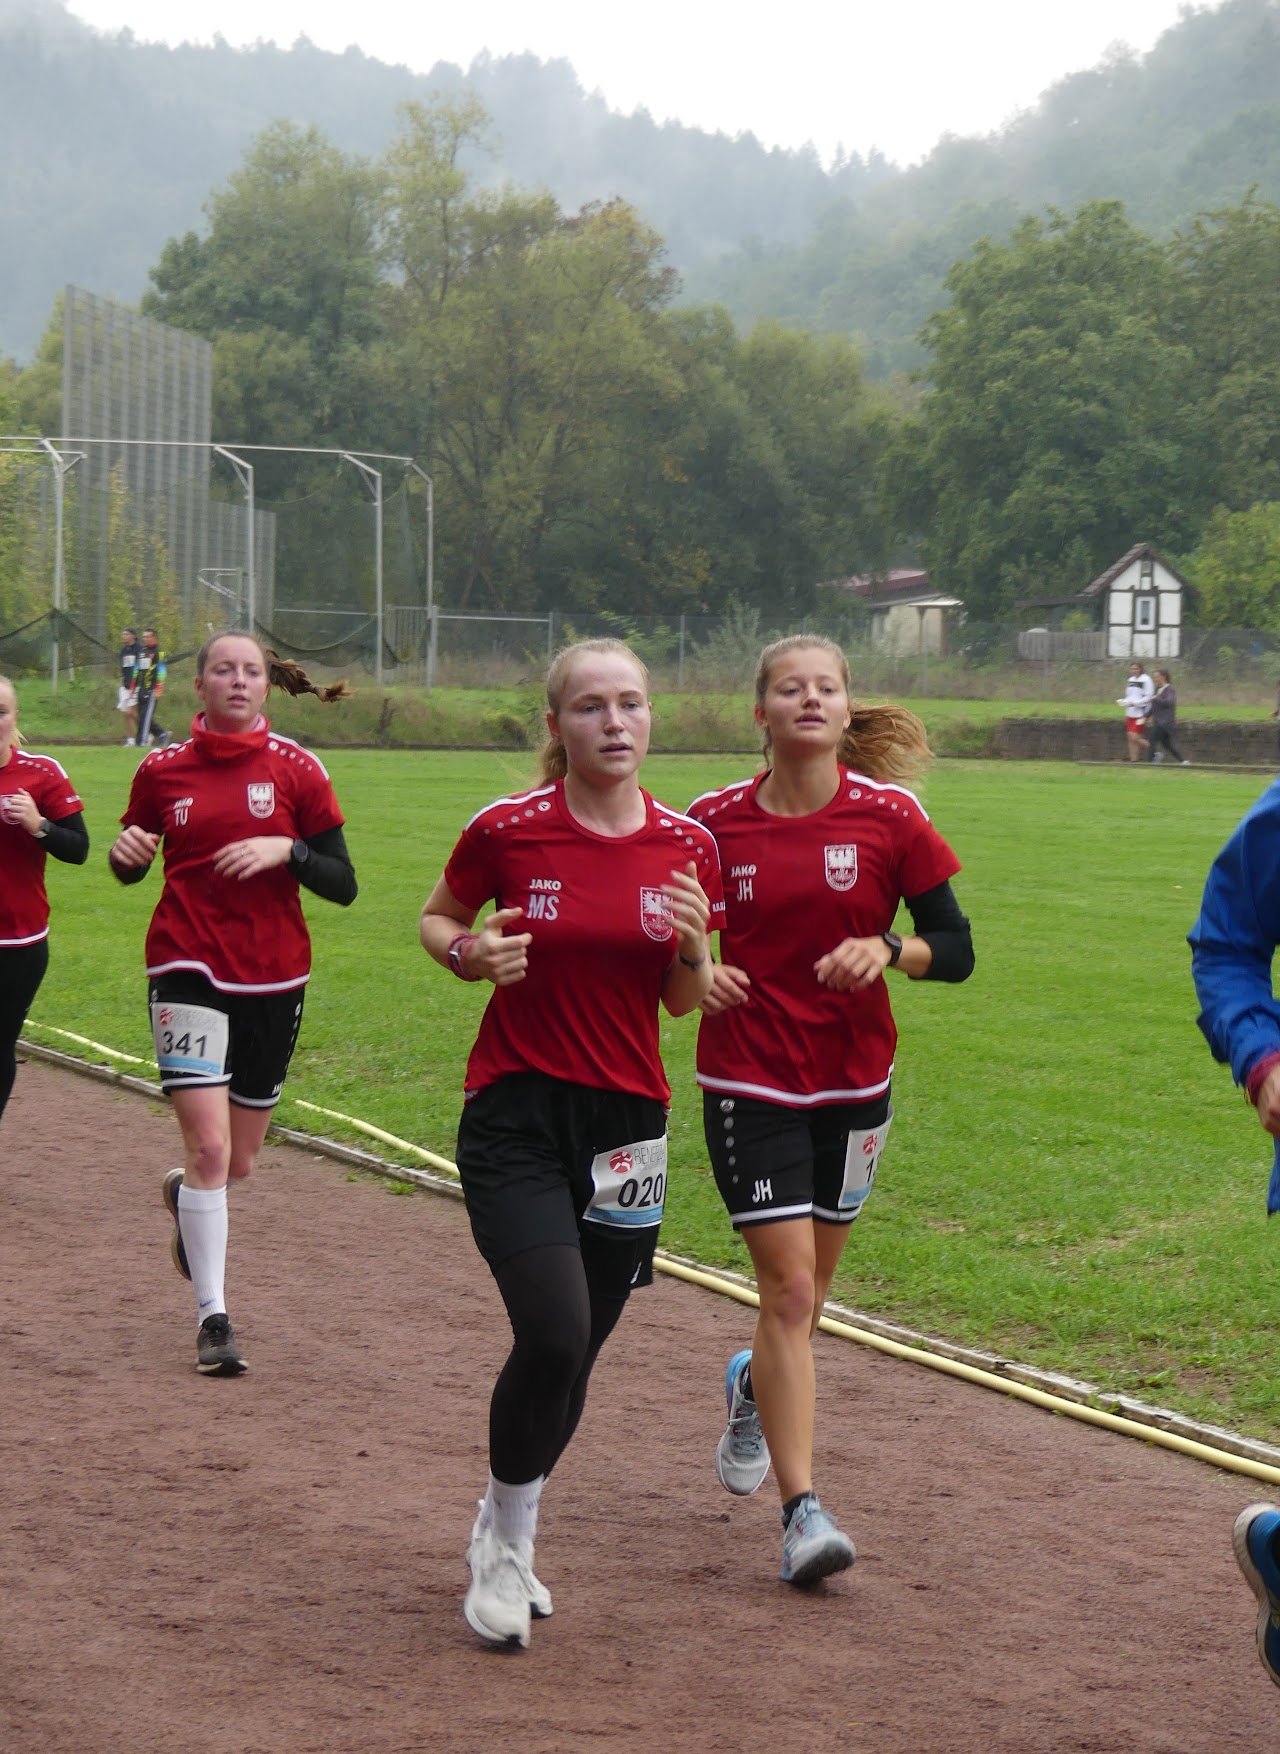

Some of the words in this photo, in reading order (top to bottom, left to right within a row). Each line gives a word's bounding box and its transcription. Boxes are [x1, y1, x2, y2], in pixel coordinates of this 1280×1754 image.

[174, 807, 189, 827] TU
[730, 864, 757, 878] JAKO
[529, 878, 562, 892] JAKO
[736, 878, 754, 902] JH
[526, 894, 560, 921] MS
[162, 1031, 208, 1058] 341
[617, 1172, 664, 1208] 020
[752, 1178, 774, 1204] JH
